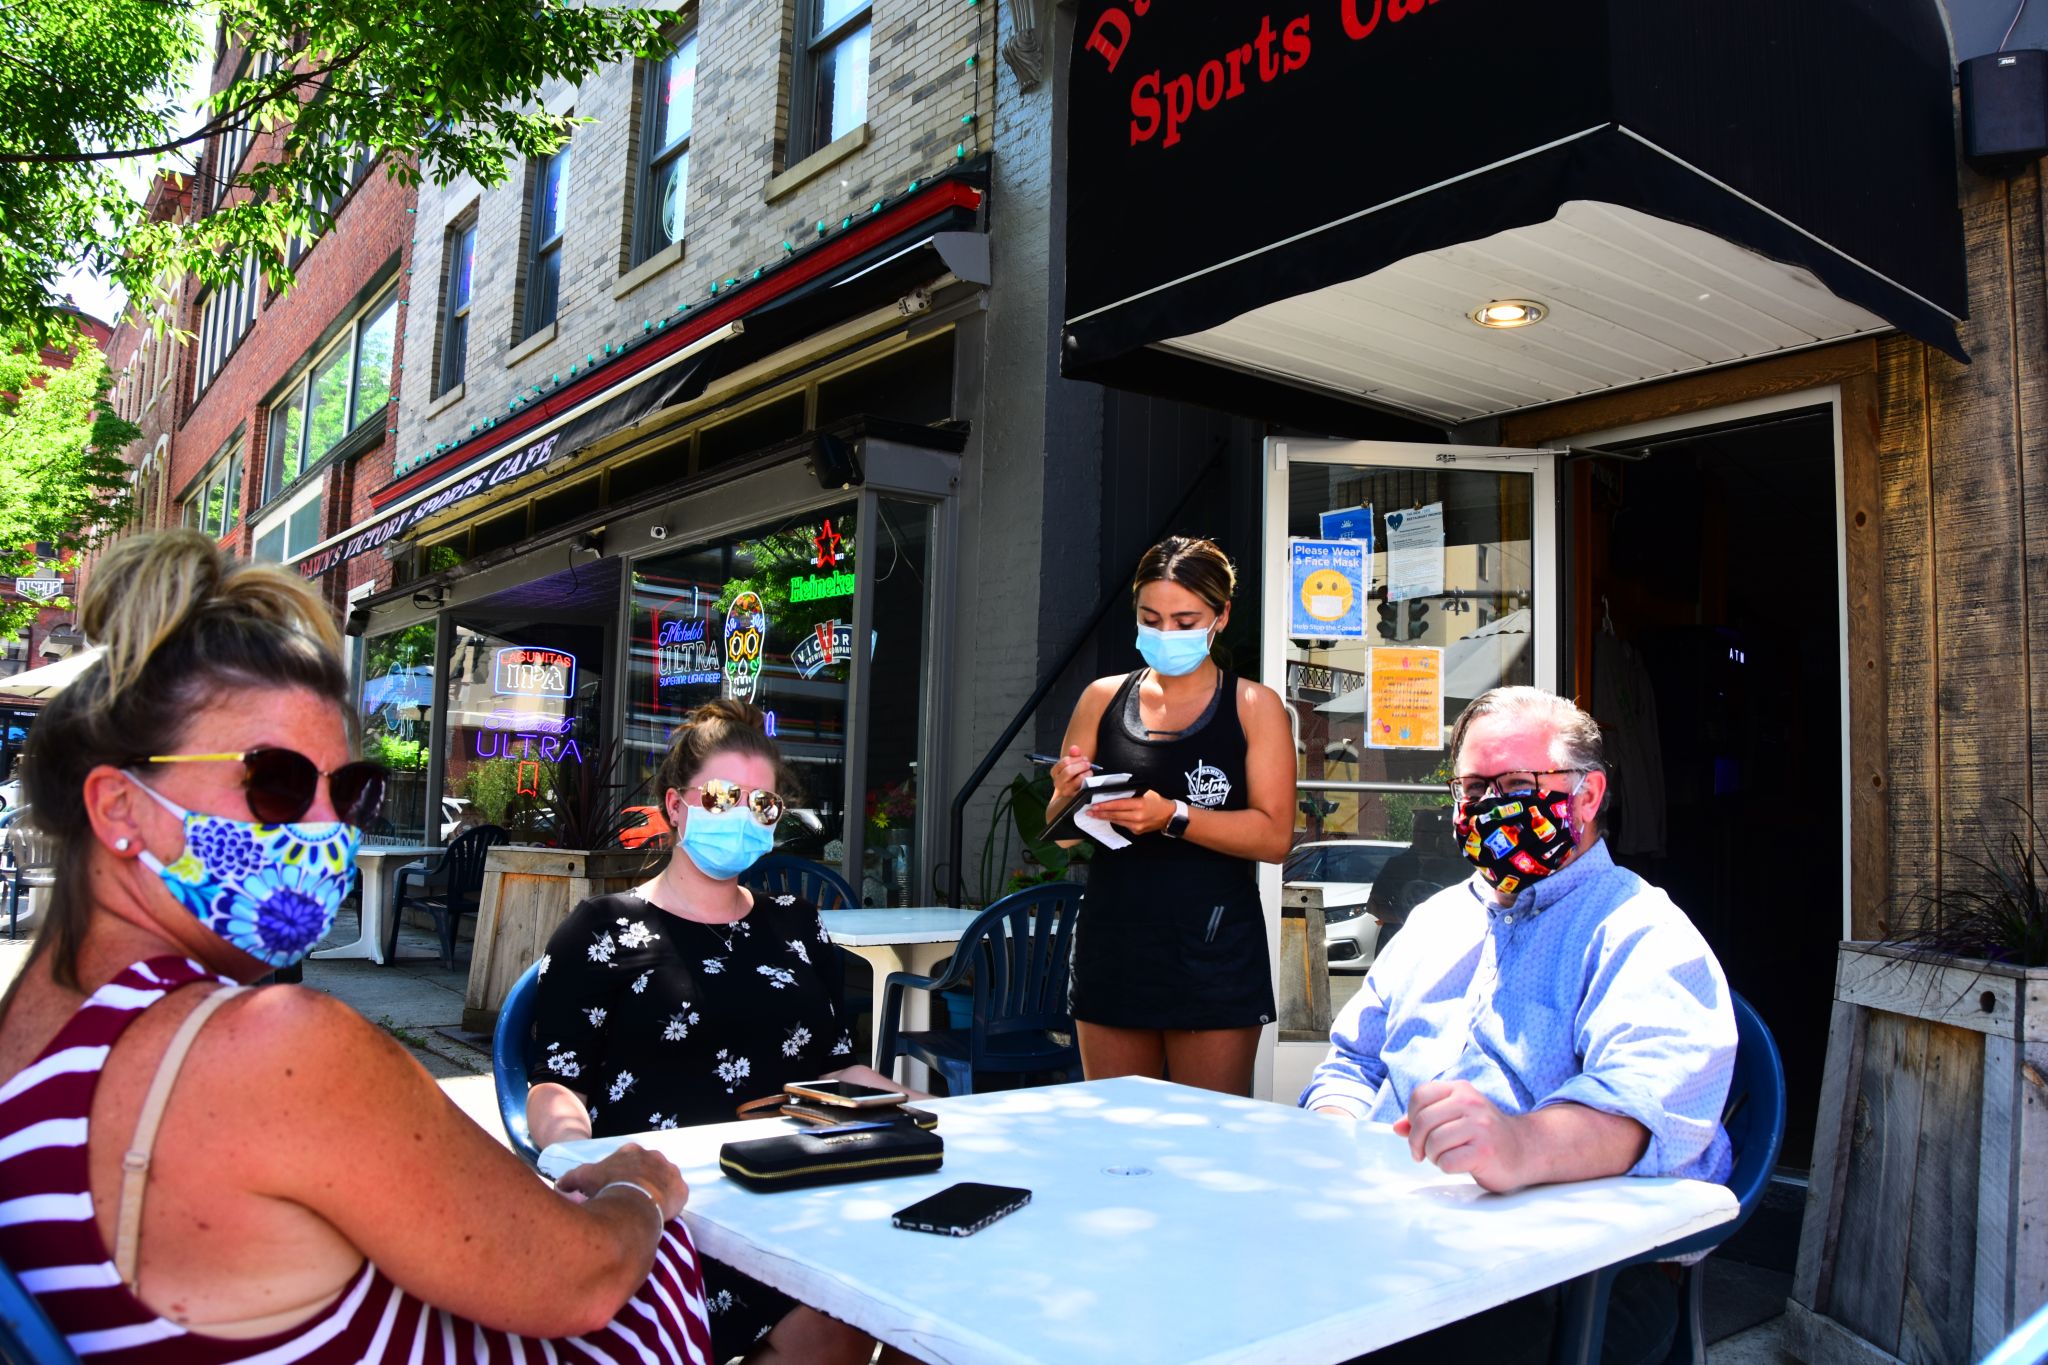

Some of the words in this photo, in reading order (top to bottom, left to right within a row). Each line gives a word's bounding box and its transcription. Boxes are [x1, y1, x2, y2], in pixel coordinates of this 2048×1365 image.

[1130, 14, 1312, 149] Sports
[1340, 0, 1441, 41] Ca
[299, 544, 344, 578] DAWN'S
[343, 509, 412, 560] VICTORY
[408, 469, 490, 526] SPORTS
[488, 432, 560, 486] CAFE
[1295, 545, 1329, 555] Please
[1331, 547, 1361, 557] Wear
[1295, 557, 1302, 565] a
[1304, 557, 1330, 567] Face
[1333, 558, 1360, 568] Mask
[658, 618, 705, 647] Michelob
[1294, 623, 1309, 631] Help
[1309, 623, 1325, 632] Stop
[500, 650, 572, 668] LAGUNITAS
[658, 639, 720, 676] ULTRA
[1728, 647, 1745, 664] ATM
[506, 663, 565, 691] IPA
[476, 730, 582, 764] ULTRA
[1184, 758, 1233, 806] Victory
